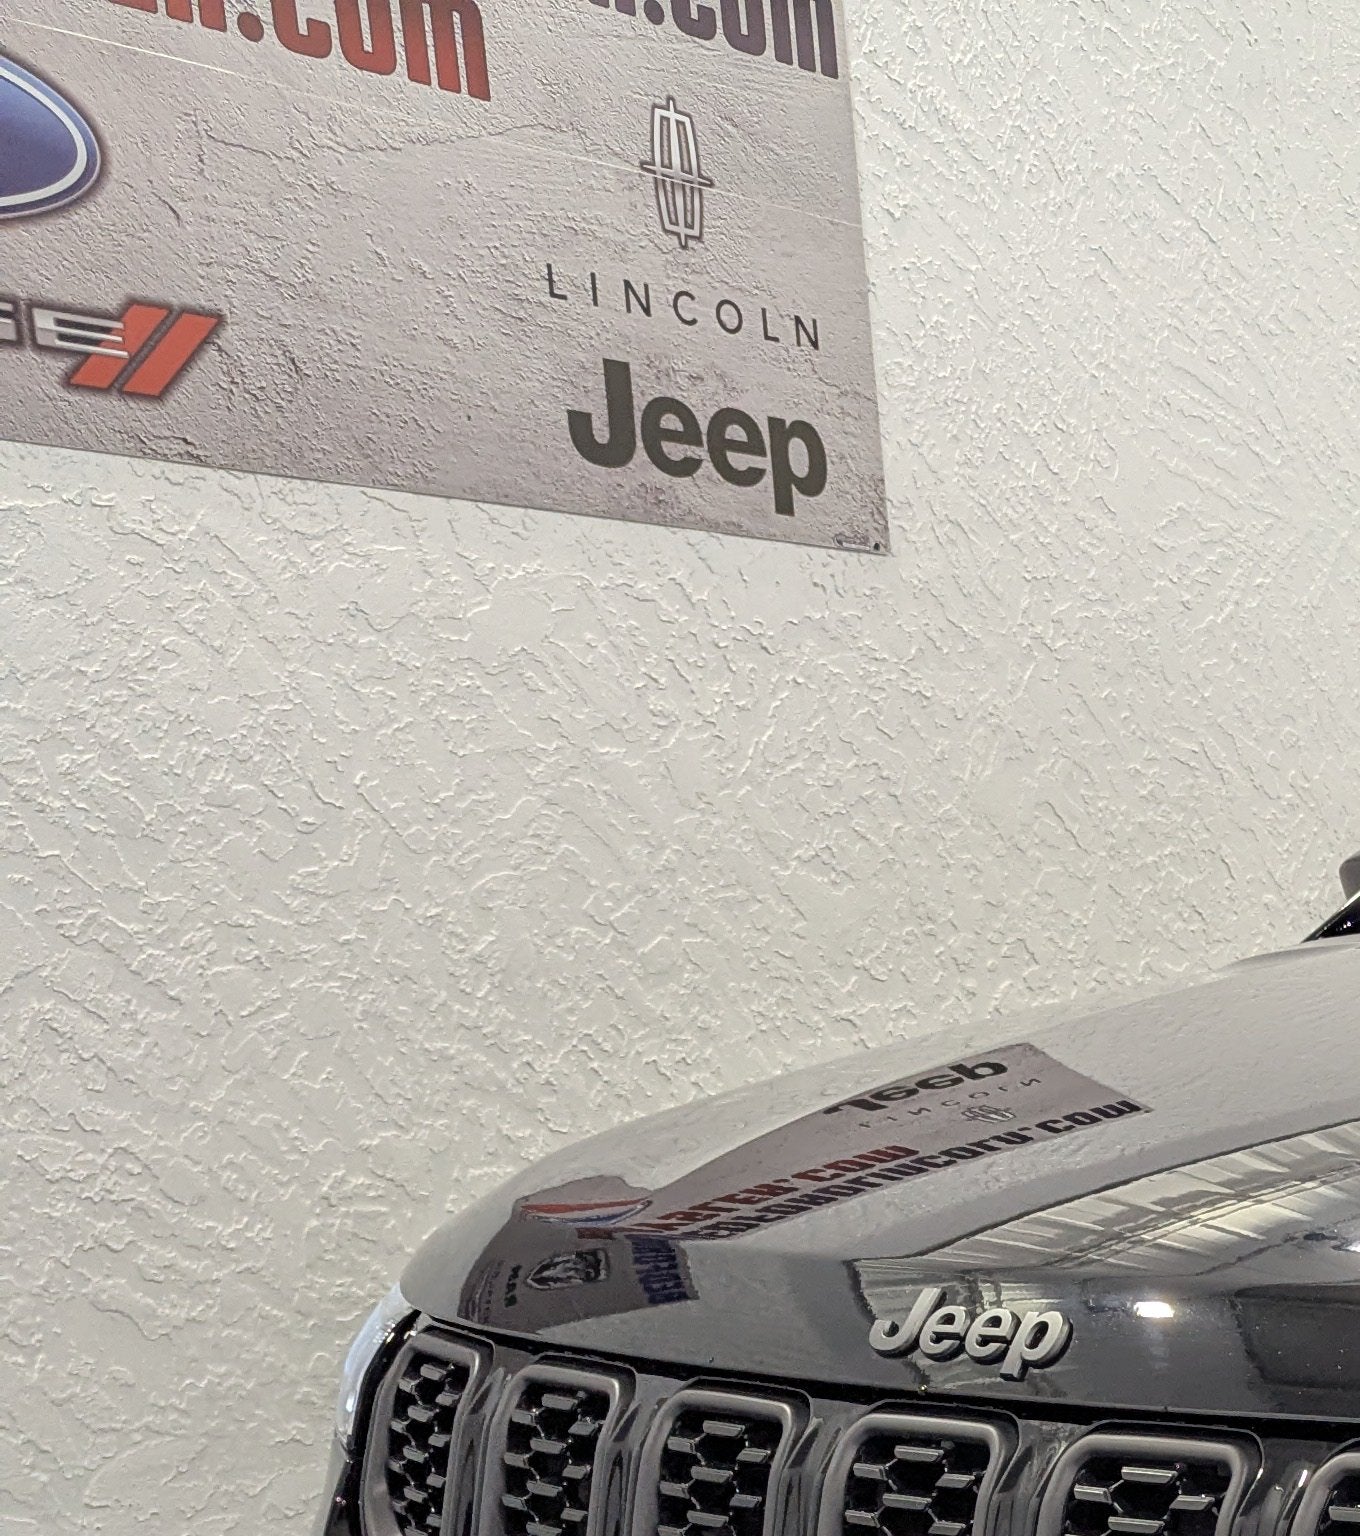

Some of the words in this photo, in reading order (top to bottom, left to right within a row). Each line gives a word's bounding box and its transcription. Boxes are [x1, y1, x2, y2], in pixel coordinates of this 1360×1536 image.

[109, 0, 491, 102] .com
[588, 0, 839, 80] .com
[546, 263, 819, 351] LINCOLN
[567, 358, 828, 517] Jeep
[868, 1287, 1073, 1382] Jeep
